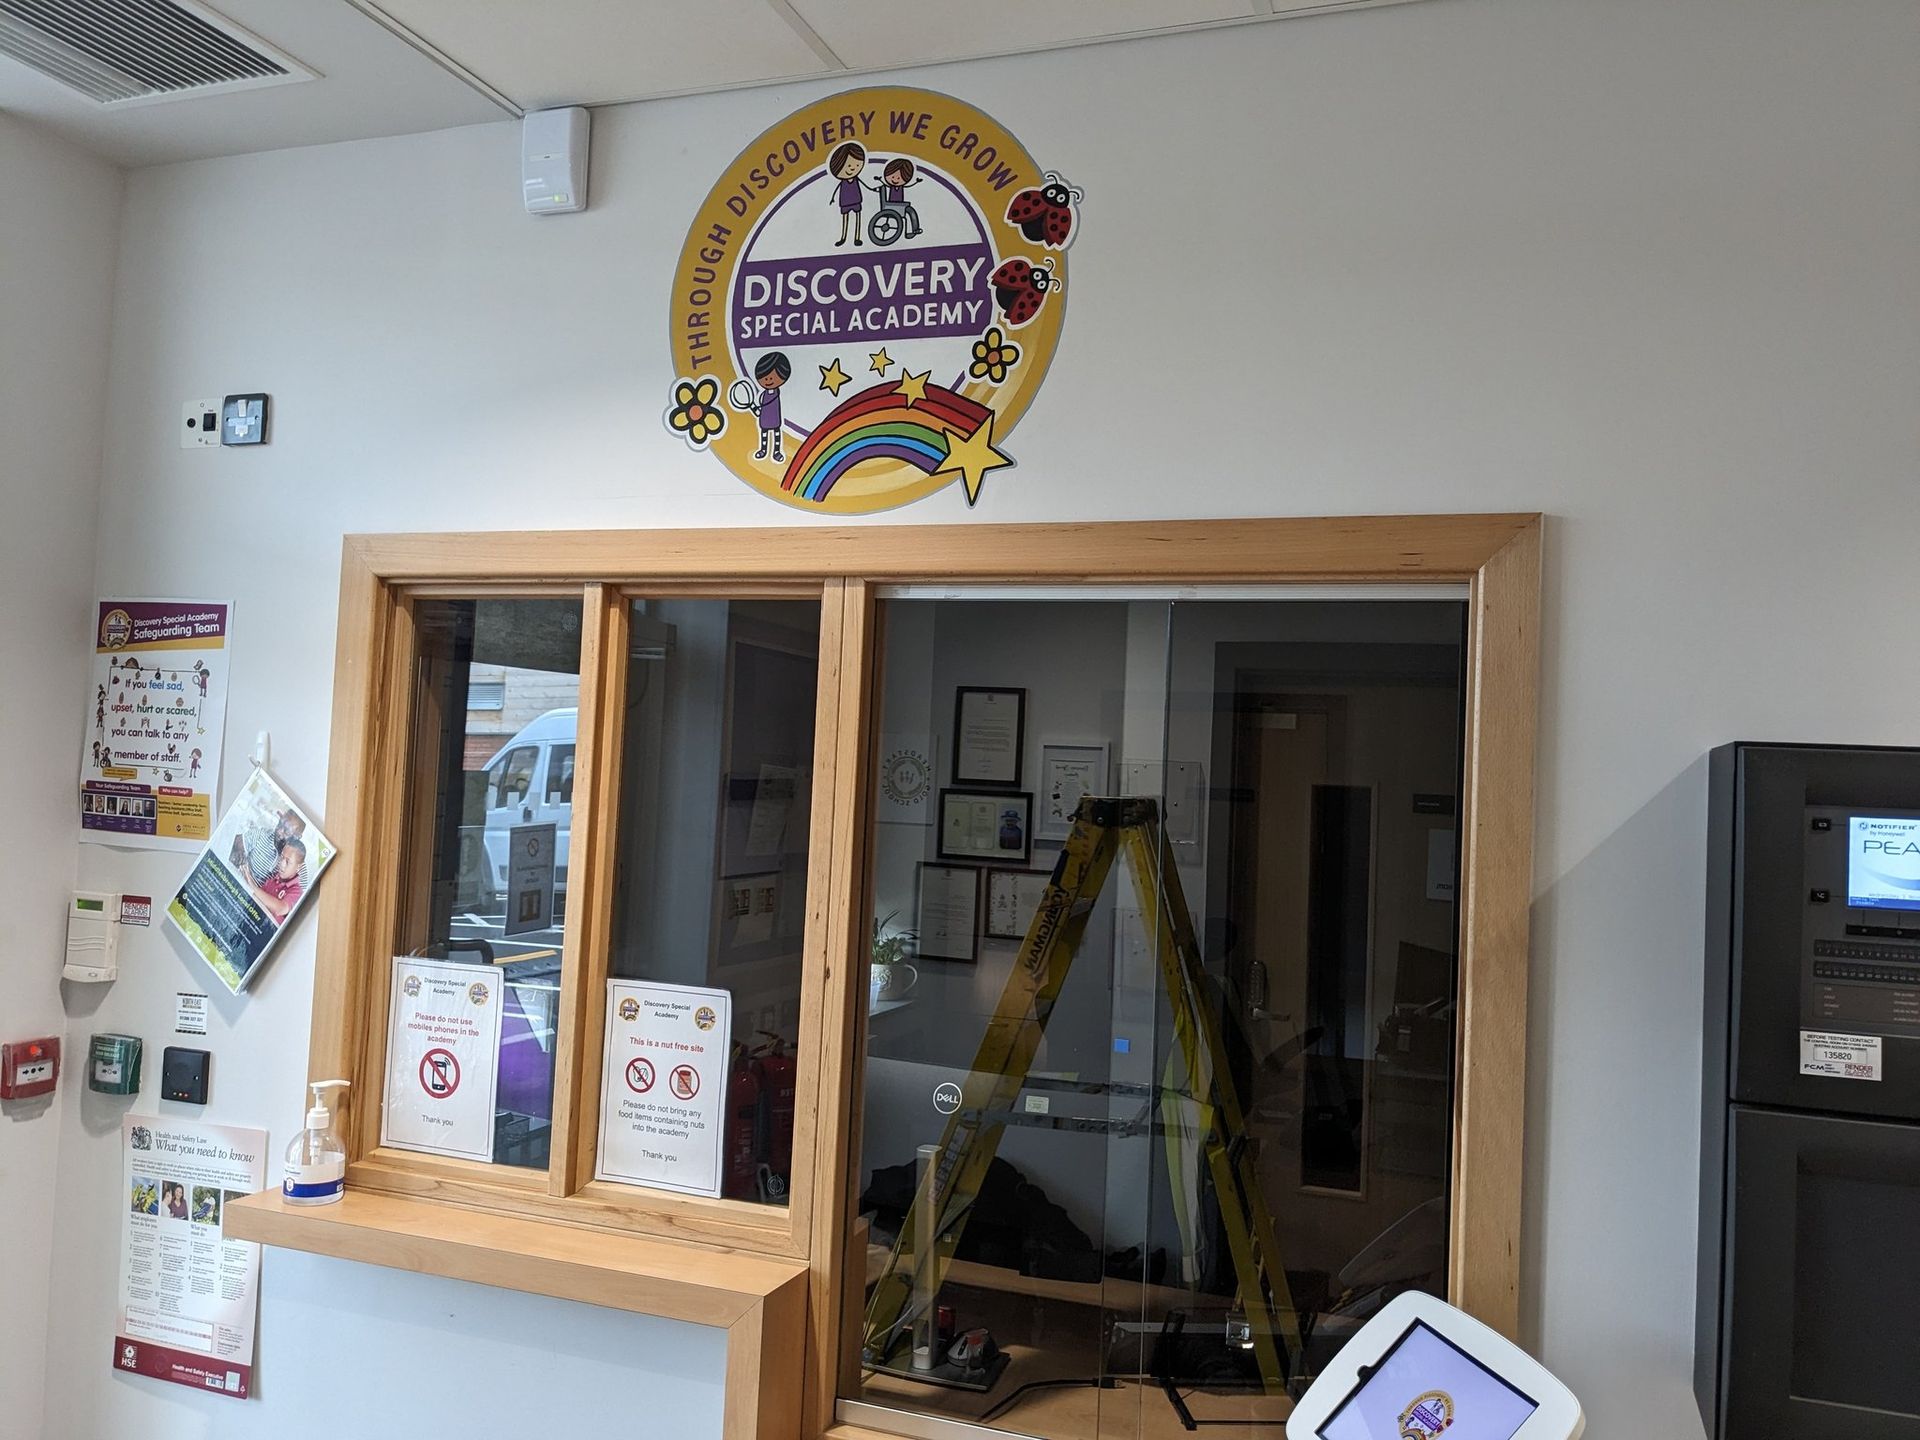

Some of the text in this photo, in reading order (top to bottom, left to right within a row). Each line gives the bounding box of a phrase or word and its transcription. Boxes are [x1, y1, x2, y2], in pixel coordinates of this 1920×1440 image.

[689, 110, 1018, 370] THROUGH DISCOVERY WE GROW
[743, 256, 986, 309] DISCOVERY
[740, 300, 984, 339] SPECIAL ACADEMY
[134, 612, 219, 627] Discovery Special Academy
[134, 626, 192, 640] Safeguarding
[194, 623, 220, 633] Team
[125, 679, 185, 692] If you feel sad,
[111, 703, 197, 717] upset, hurt or scared,
[111, 728, 189, 742] you can talk to any
[114, 751, 182, 763] member of staff.
[424, 977, 467, 987] Discovery Special
[433, 987, 455, 996] Academy
[643, 1000, 691, 1011] Discovery Special
[415, 1012, 473, 1026] Please do not use
[654, 1011, 679, 1020] Academy
[408, 1023, 480, 1037] mobiles phones in the
[427, 1034, 457, 1045] academy
[630, 1036, 645, 1046] This
[646, 1038, 654, 1046] is
[661, 1041, 674, 1050] nut
[674, 1041, 689, 1051] free
[690, 1043, 704, 1053] site
[1824, 1051, 1852, 1061] 135820
[1804, 1063, 1825, 1071] FCM
[936, 1092, 959, 1104] DELL
[623, 1099, 702, 1119] Please do not bring any
[422, 1114, 454, 1127] Thank you
[618, 1110, 705, 1130] food items containing nuts
[632, 1122, 690, 1139] into the academy
[155, 1131, 208, 1144] Health and Safety Law
[155, 1139, 256, 1163] What you need to know
[642, 1149, 677, 1162] Thank you
[121, 1357, 137, 1369] HSE
